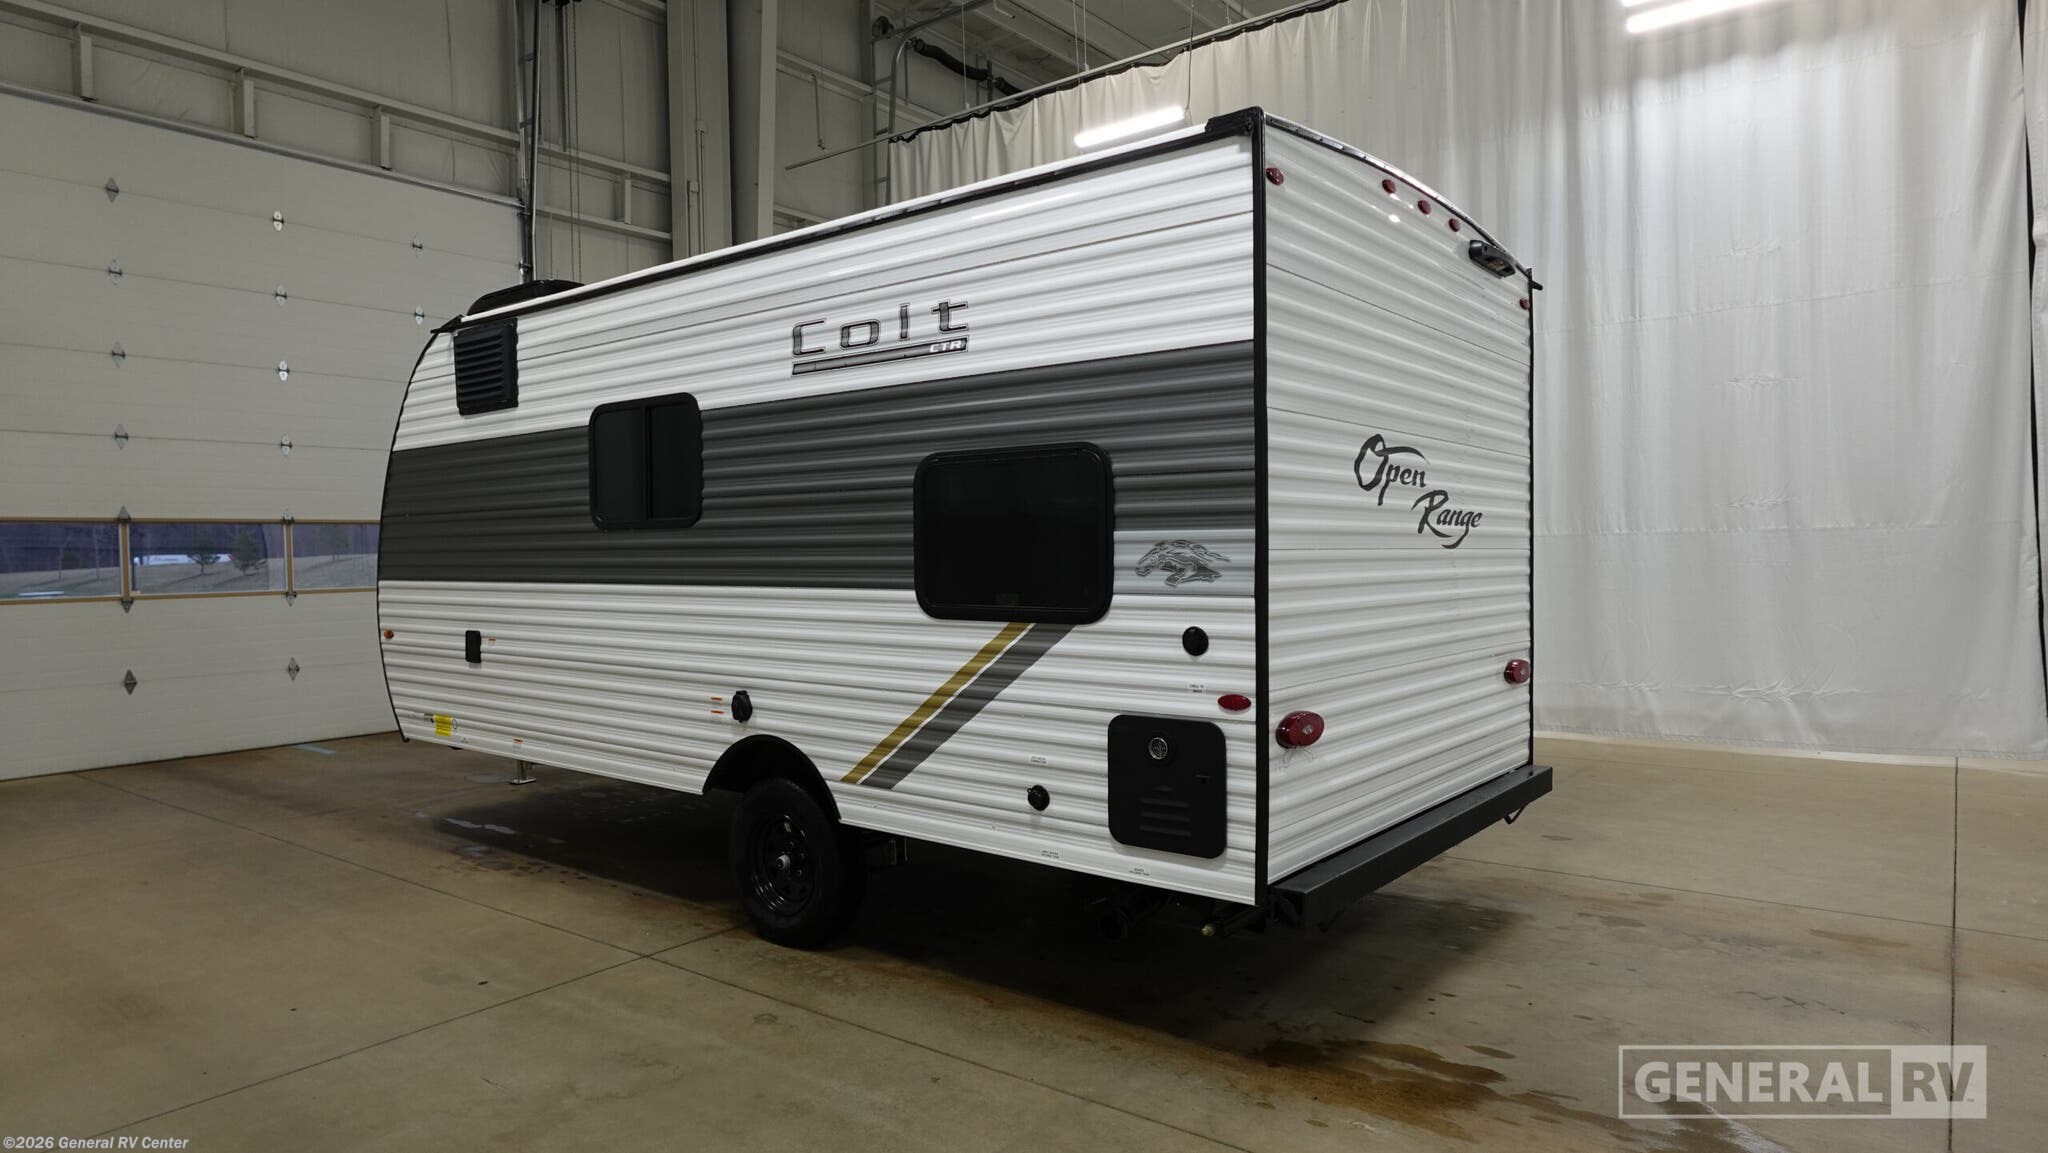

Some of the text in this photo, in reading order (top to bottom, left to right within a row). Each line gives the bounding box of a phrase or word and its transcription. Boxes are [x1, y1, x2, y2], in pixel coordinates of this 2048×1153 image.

[792, 301, 968, 356] Colt
[929, 340, 962, 353] CTR
[1354, 434, 1430, 506] Open
[1410, 490, 1483, 549] Range
